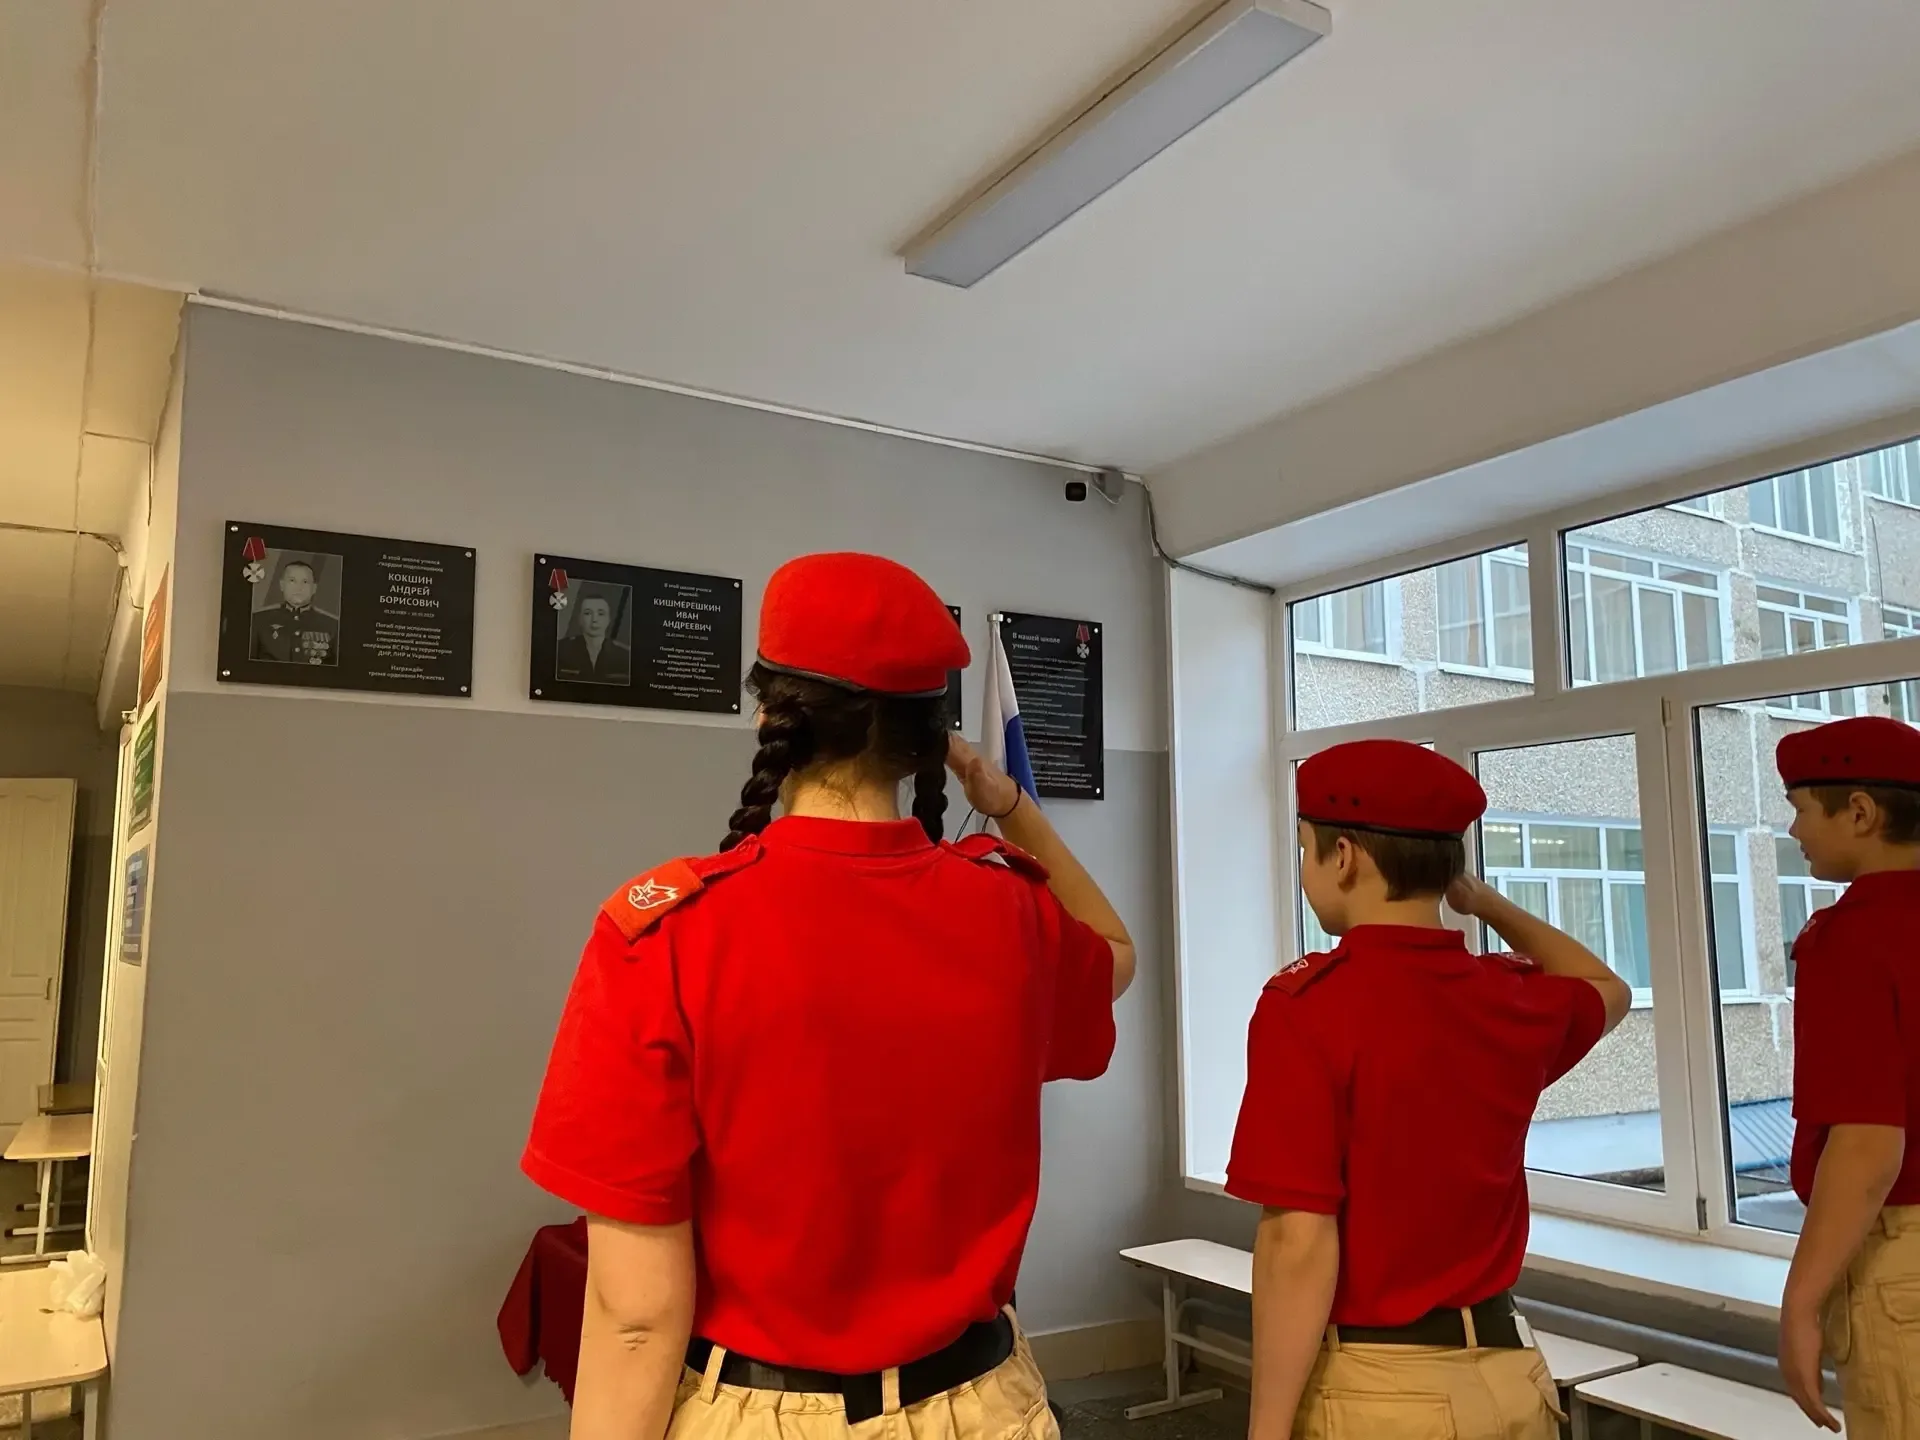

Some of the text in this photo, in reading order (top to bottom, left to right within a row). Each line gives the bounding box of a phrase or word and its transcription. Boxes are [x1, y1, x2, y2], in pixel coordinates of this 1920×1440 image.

[388, 572, 432, 584] КОКШИН
[390, 585, 430, 596] АНДРЕЙ
[379, 596, 439, 608] БОРИСОВИЧ
[654, 598, 721, 612] КИШМЕРЕШКИН
[676, 611, 698, 620] ИВАН
[662, 620, 711, 632] АНДРЕЕВИЧ
